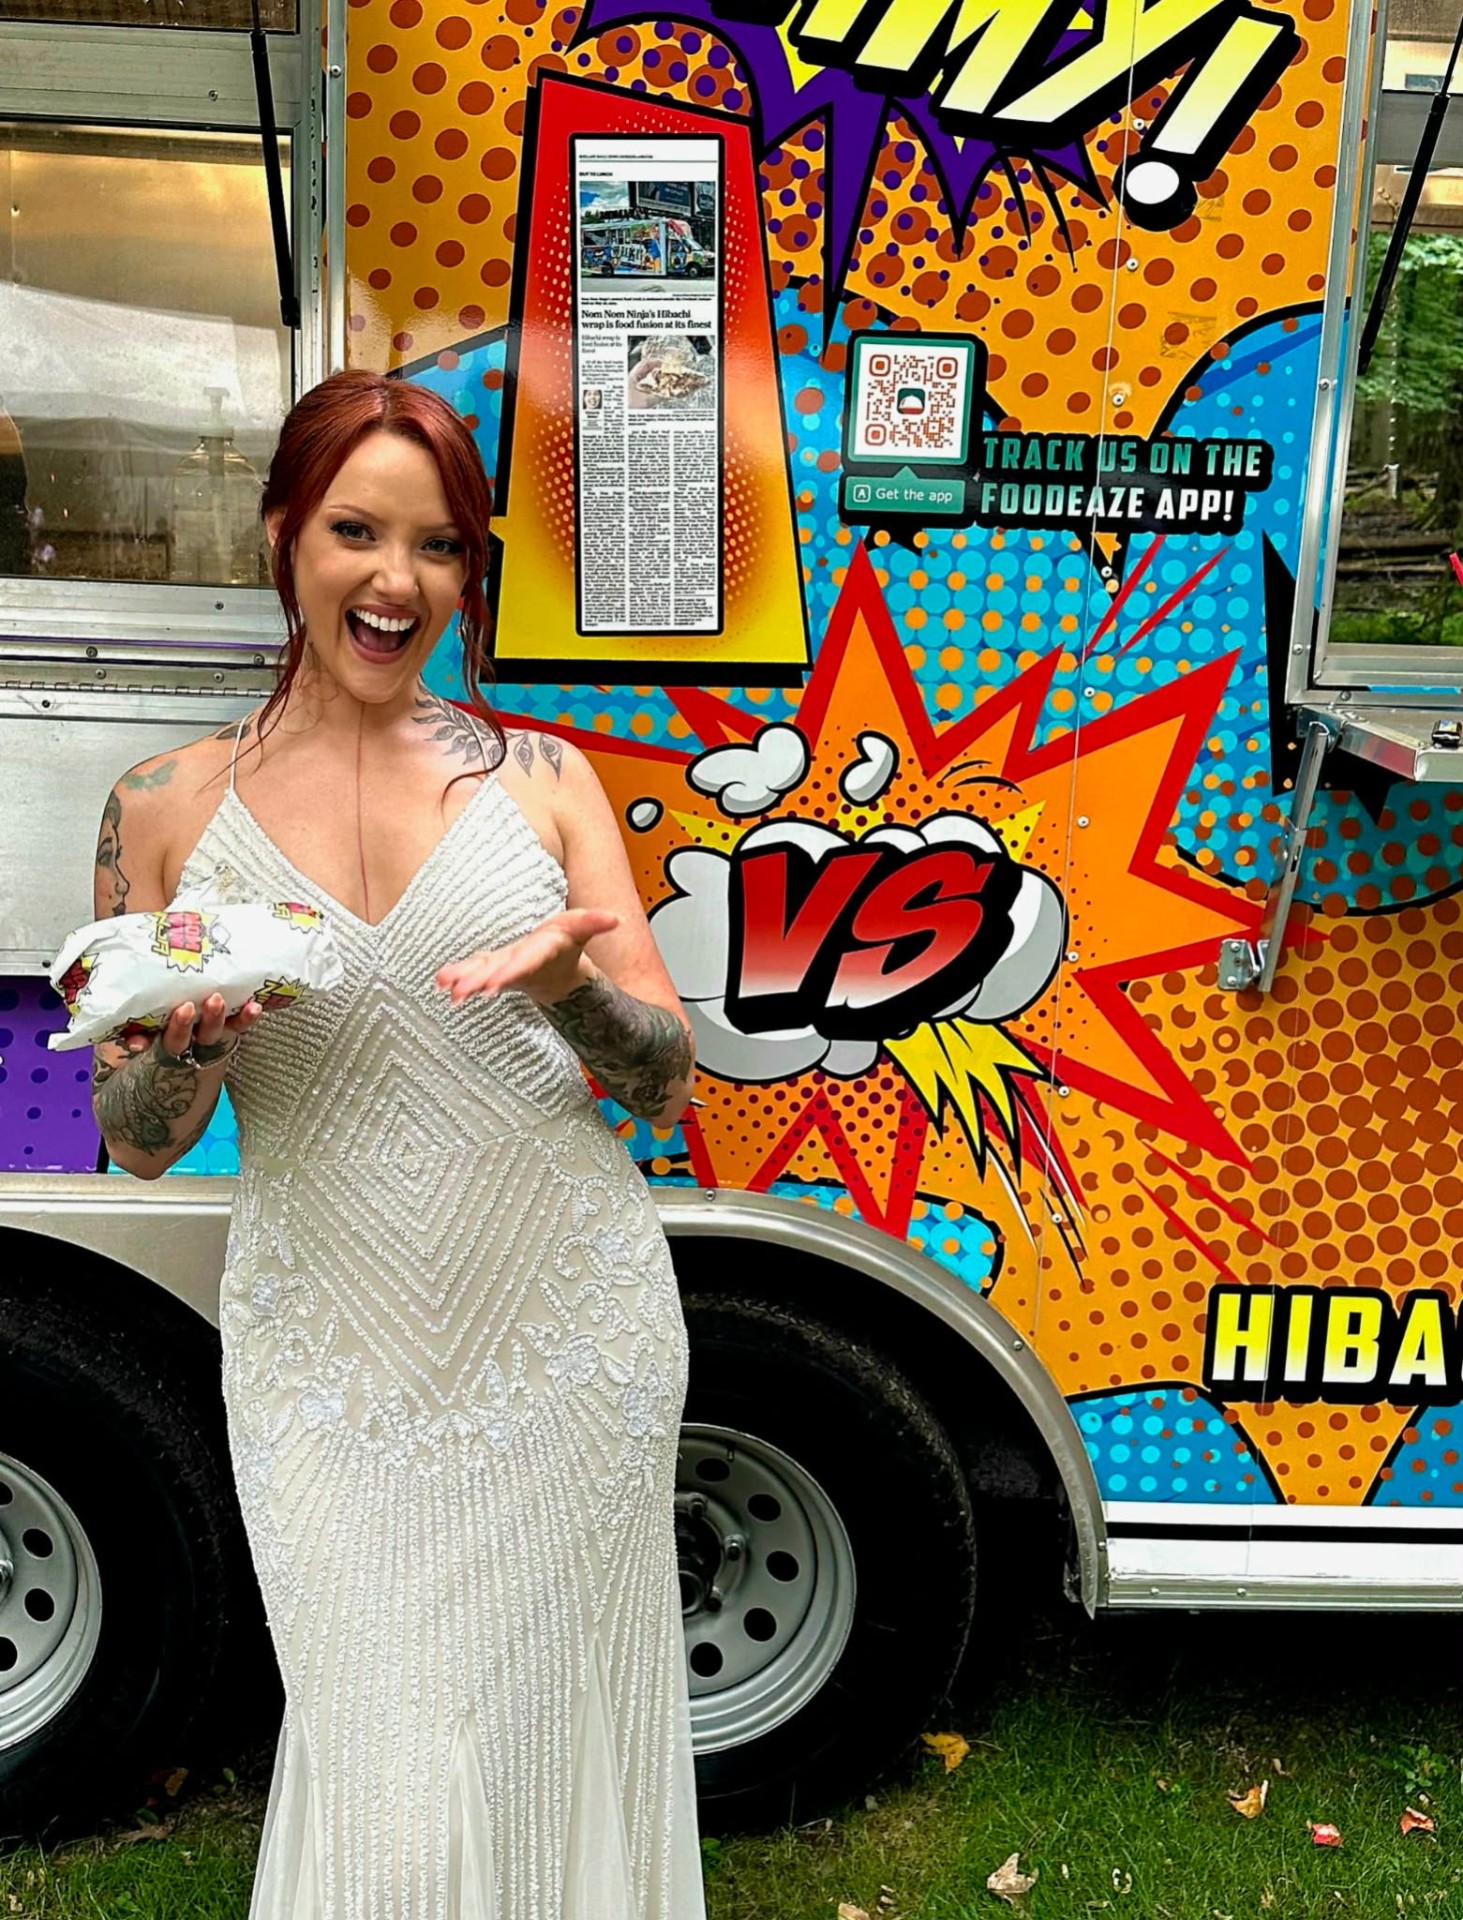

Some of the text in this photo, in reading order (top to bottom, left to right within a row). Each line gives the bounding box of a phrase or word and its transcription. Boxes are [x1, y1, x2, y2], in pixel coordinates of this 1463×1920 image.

[581, 310, 691, 320] Nom Nom Ninja's Hibachi
[581, 320, 712, 330] wrap is food fusion at its finest
[983, 437, 1263, 477] TRACK US ON THE
[875, 488, 953, 504] Get the app
[981, 482, 1234, 522] FOODEAZE APP!
[738, 850, 995, 1009] VS
[1211, 1293, 1463, 1387] HIBA
